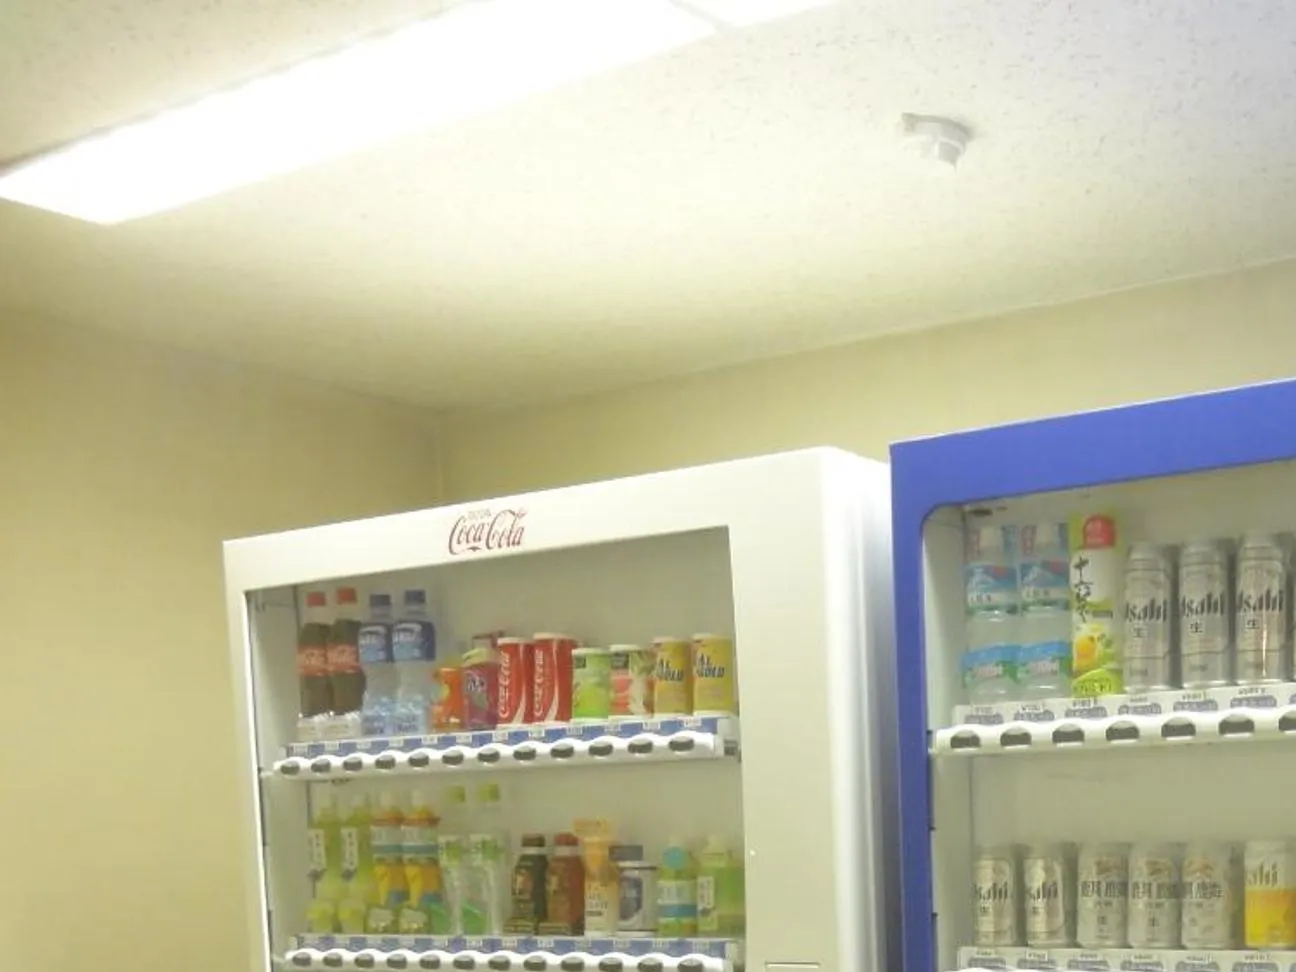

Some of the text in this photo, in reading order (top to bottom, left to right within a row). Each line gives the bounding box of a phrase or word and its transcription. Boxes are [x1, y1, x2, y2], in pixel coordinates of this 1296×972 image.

[448, 508, 527, 555] Coca-Cola
[1246, 862, 1279, 888] ahi
[973, 879, 1009, 902] sahi
